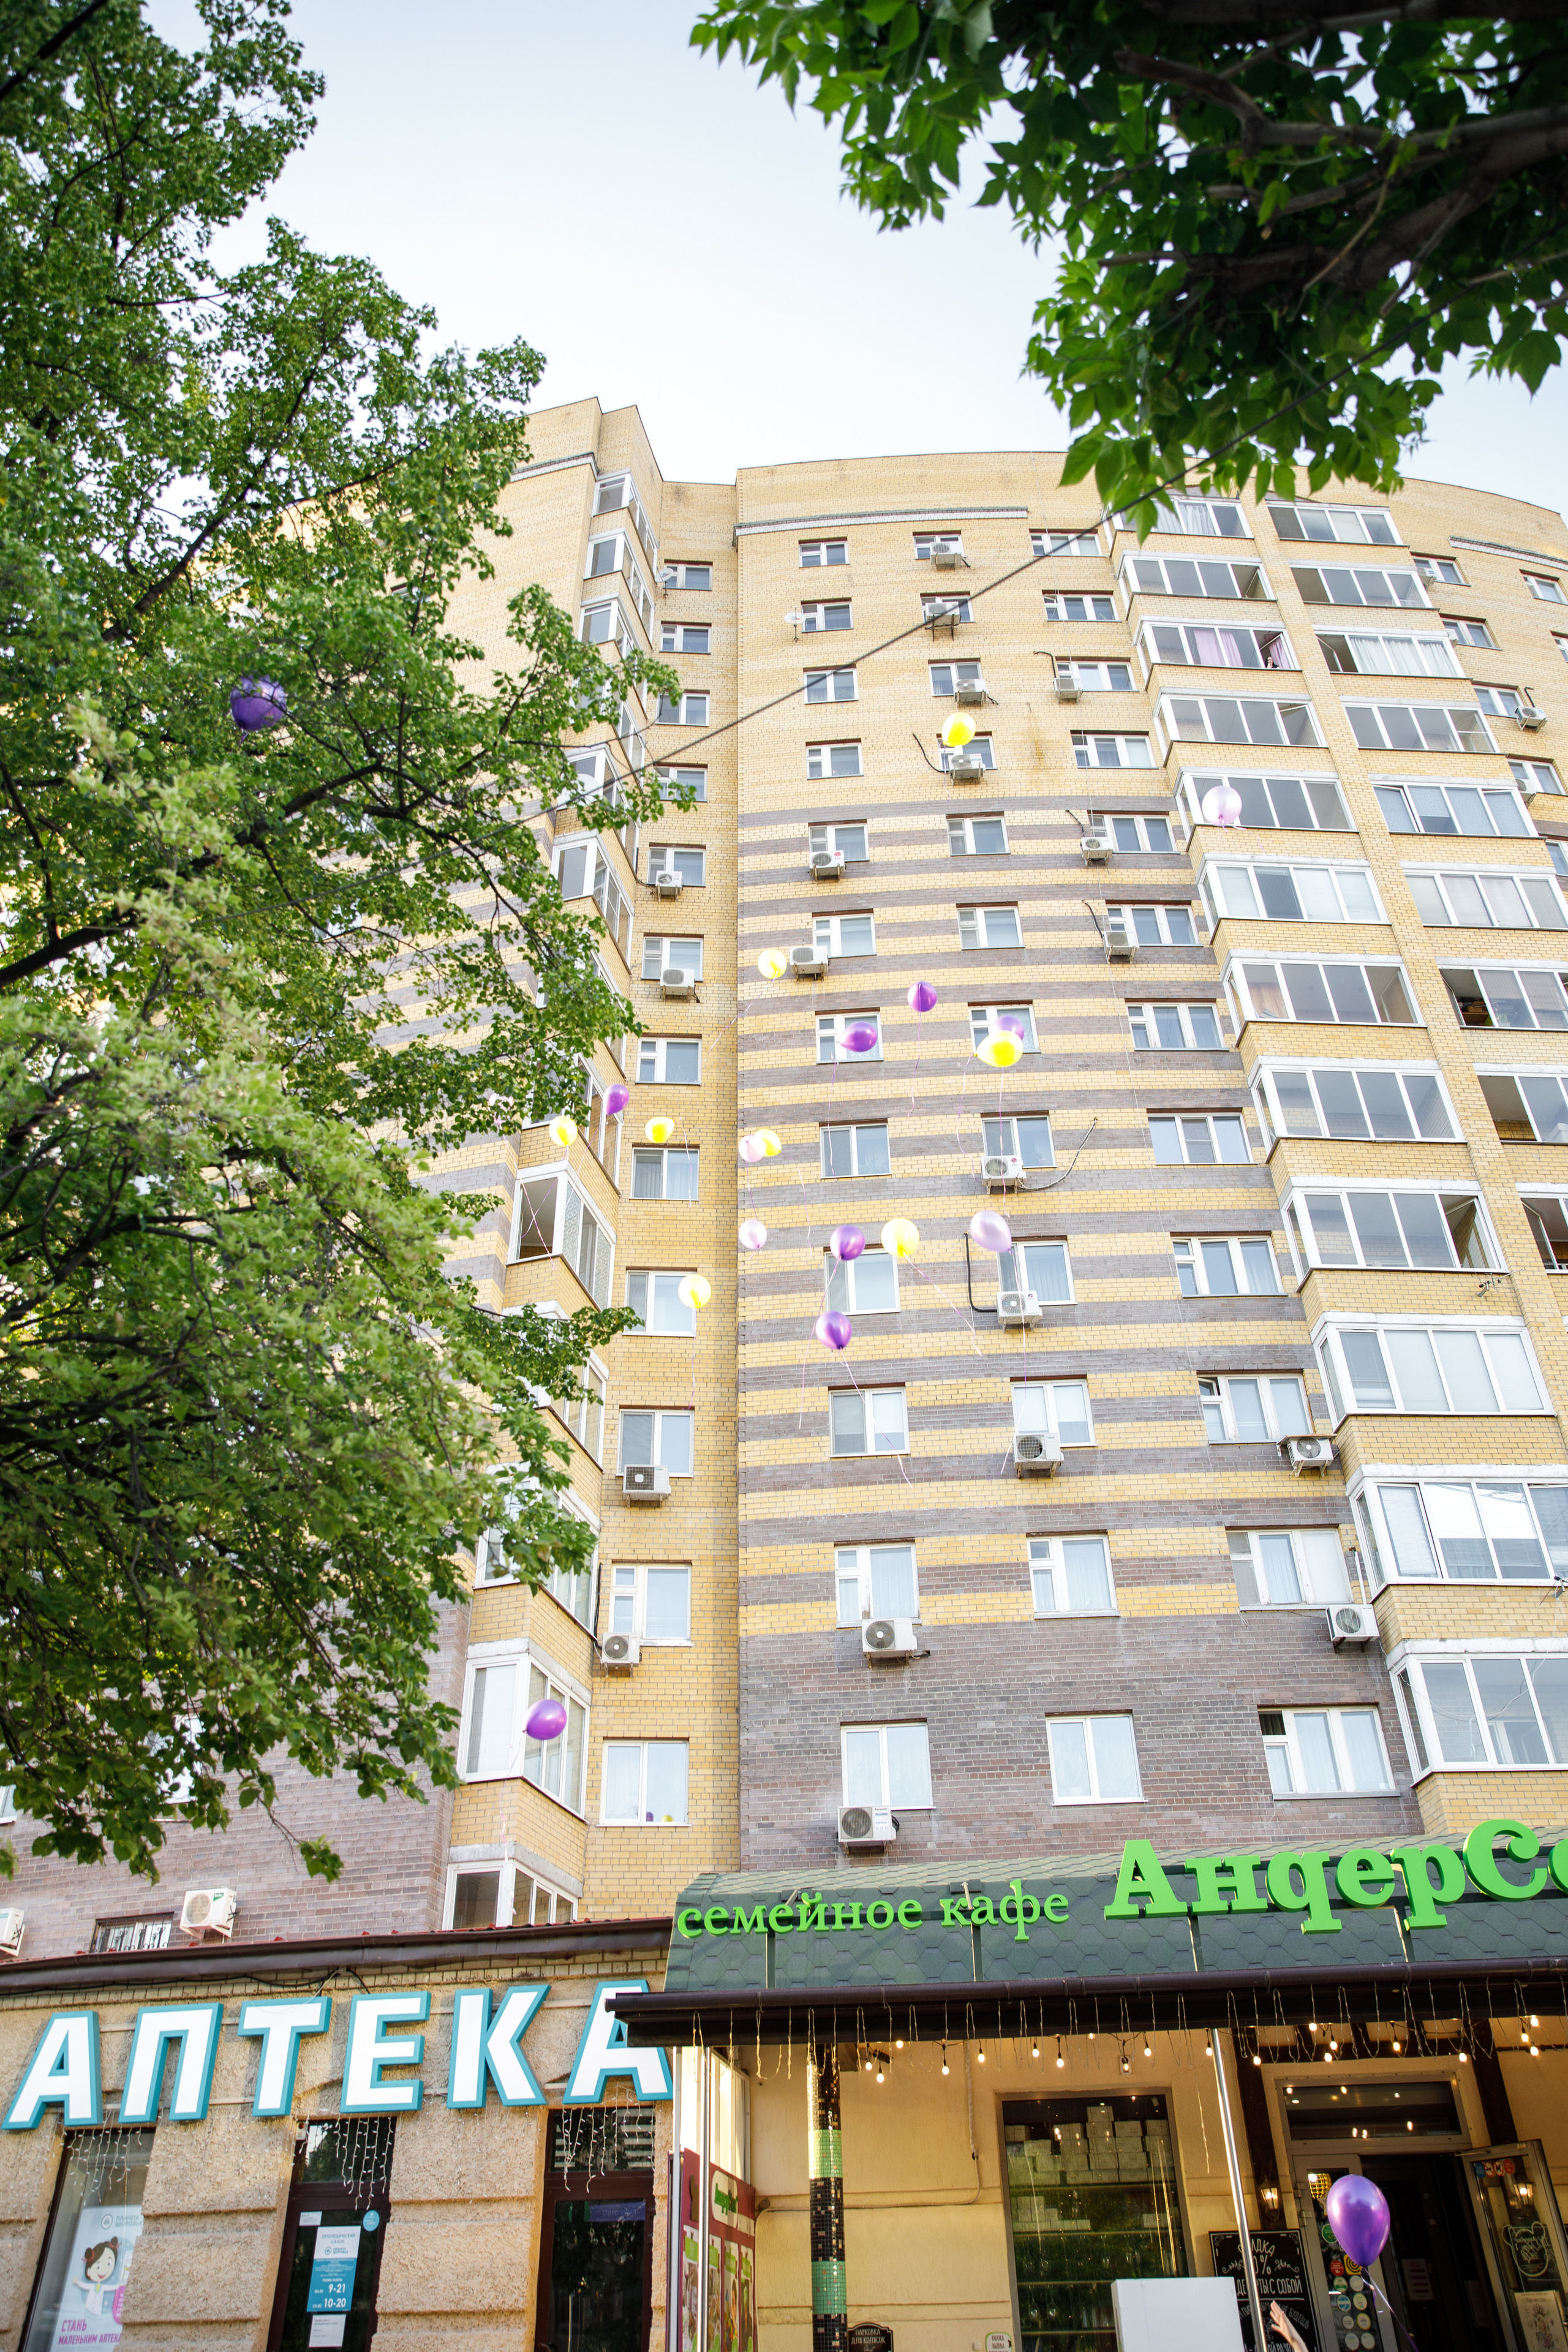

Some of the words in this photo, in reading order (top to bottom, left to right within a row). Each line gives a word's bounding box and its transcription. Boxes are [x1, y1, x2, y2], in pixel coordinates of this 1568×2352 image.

[677, 1892, 922, 1938] семейное
[940, 1879, 1069, 1942] кафе
[2, 1979, 673, 2130] АПТЕКА
[328, 2283, 346, 2293] 9-21
[1269, 2278, 1276, 2294] С
[1276, 2275, 1303, 2294] СОБОЙ
[324, 2297, 347, 2308] 10-20
[61, 2318, 87, 2332] СТАНЬ
[1289, 2307, 1310, 2329] БУДЕШЬ
[58, 2334, 98, 2345] МАЛЕНЬКИМ
[851, 2336, 862, 2345] ДЛЯ
[863, 2335, 886, 2344] КОЛЯСОК
